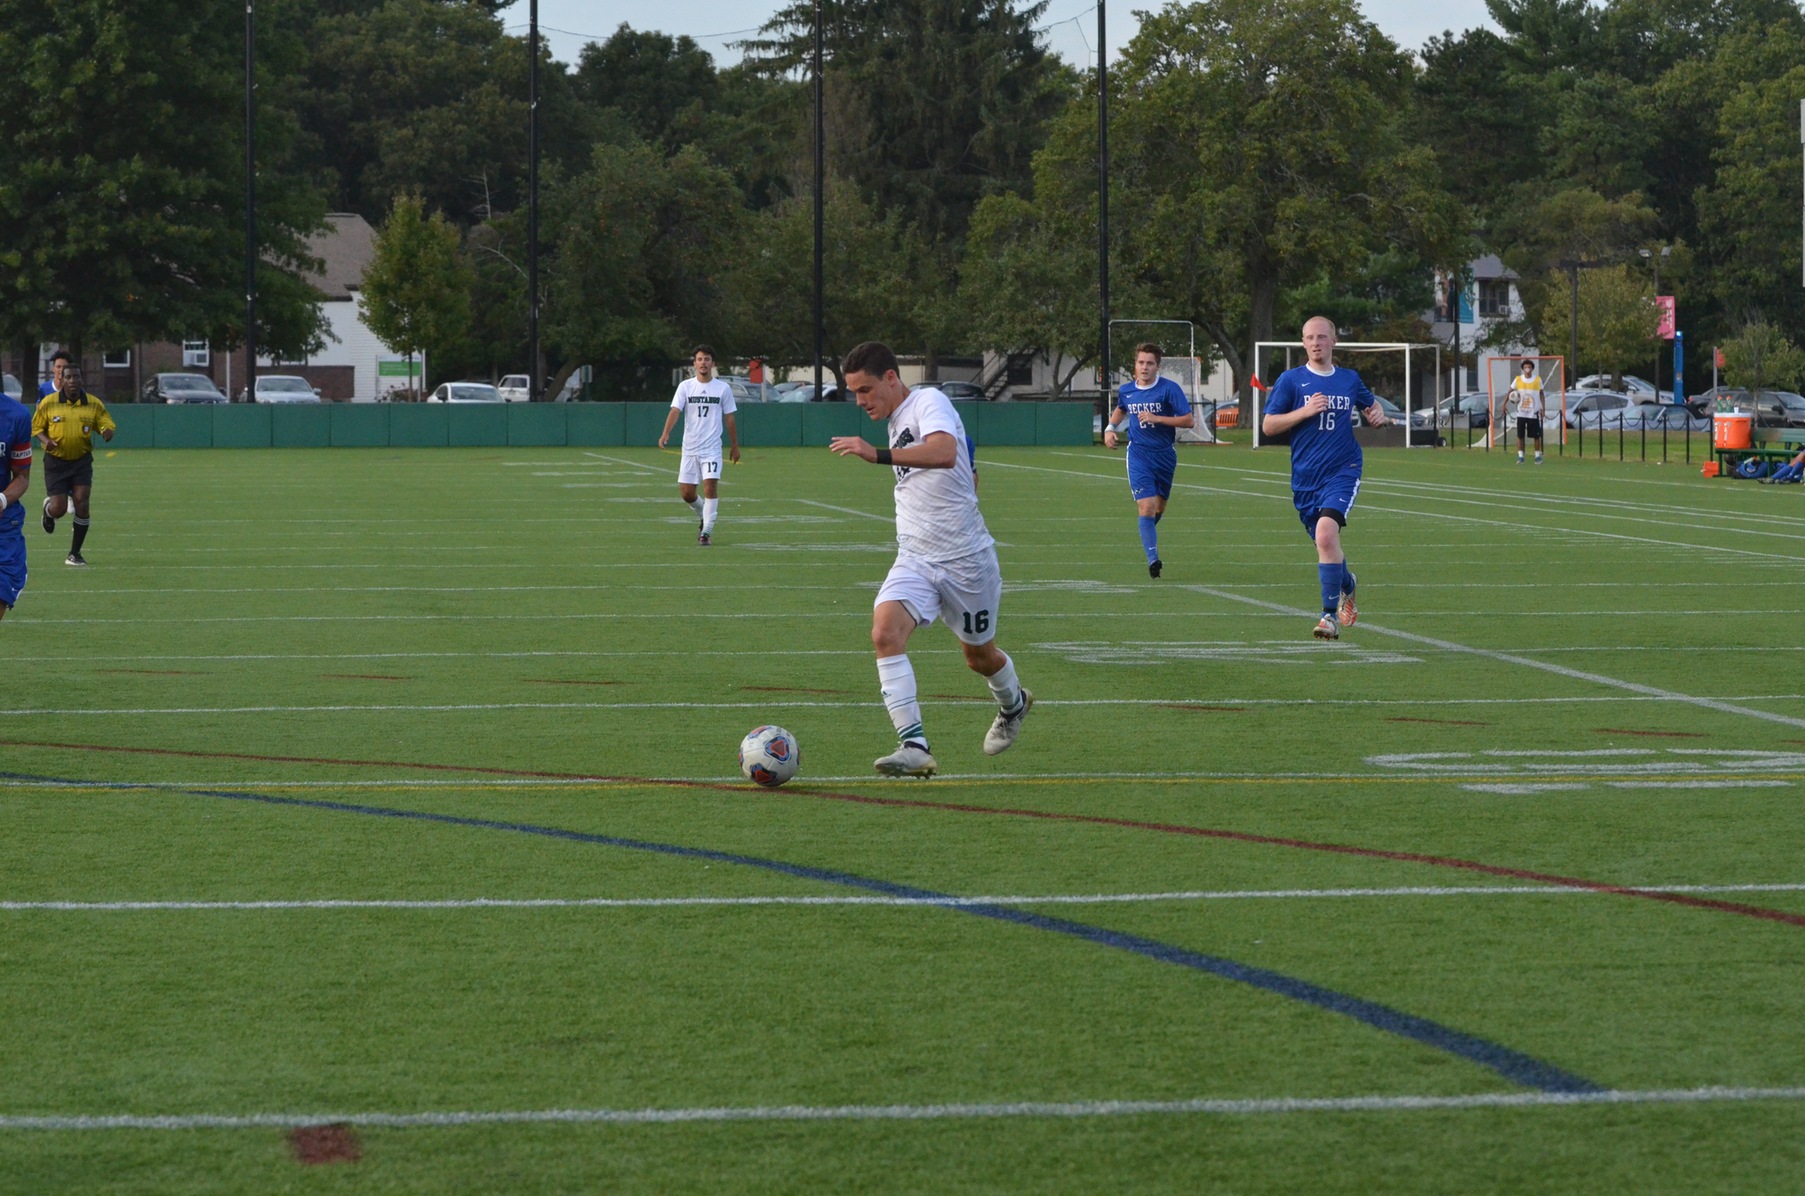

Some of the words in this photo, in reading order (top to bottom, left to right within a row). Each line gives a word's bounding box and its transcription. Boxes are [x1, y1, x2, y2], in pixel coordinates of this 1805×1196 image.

[1303, 395, 1351, 411] BKER
[697, 405, 710, 418] 17
[1318, 412, 1336, 431] 16
[707, 461, 719, 473] 17
[962, 609, 989, 635] 16
